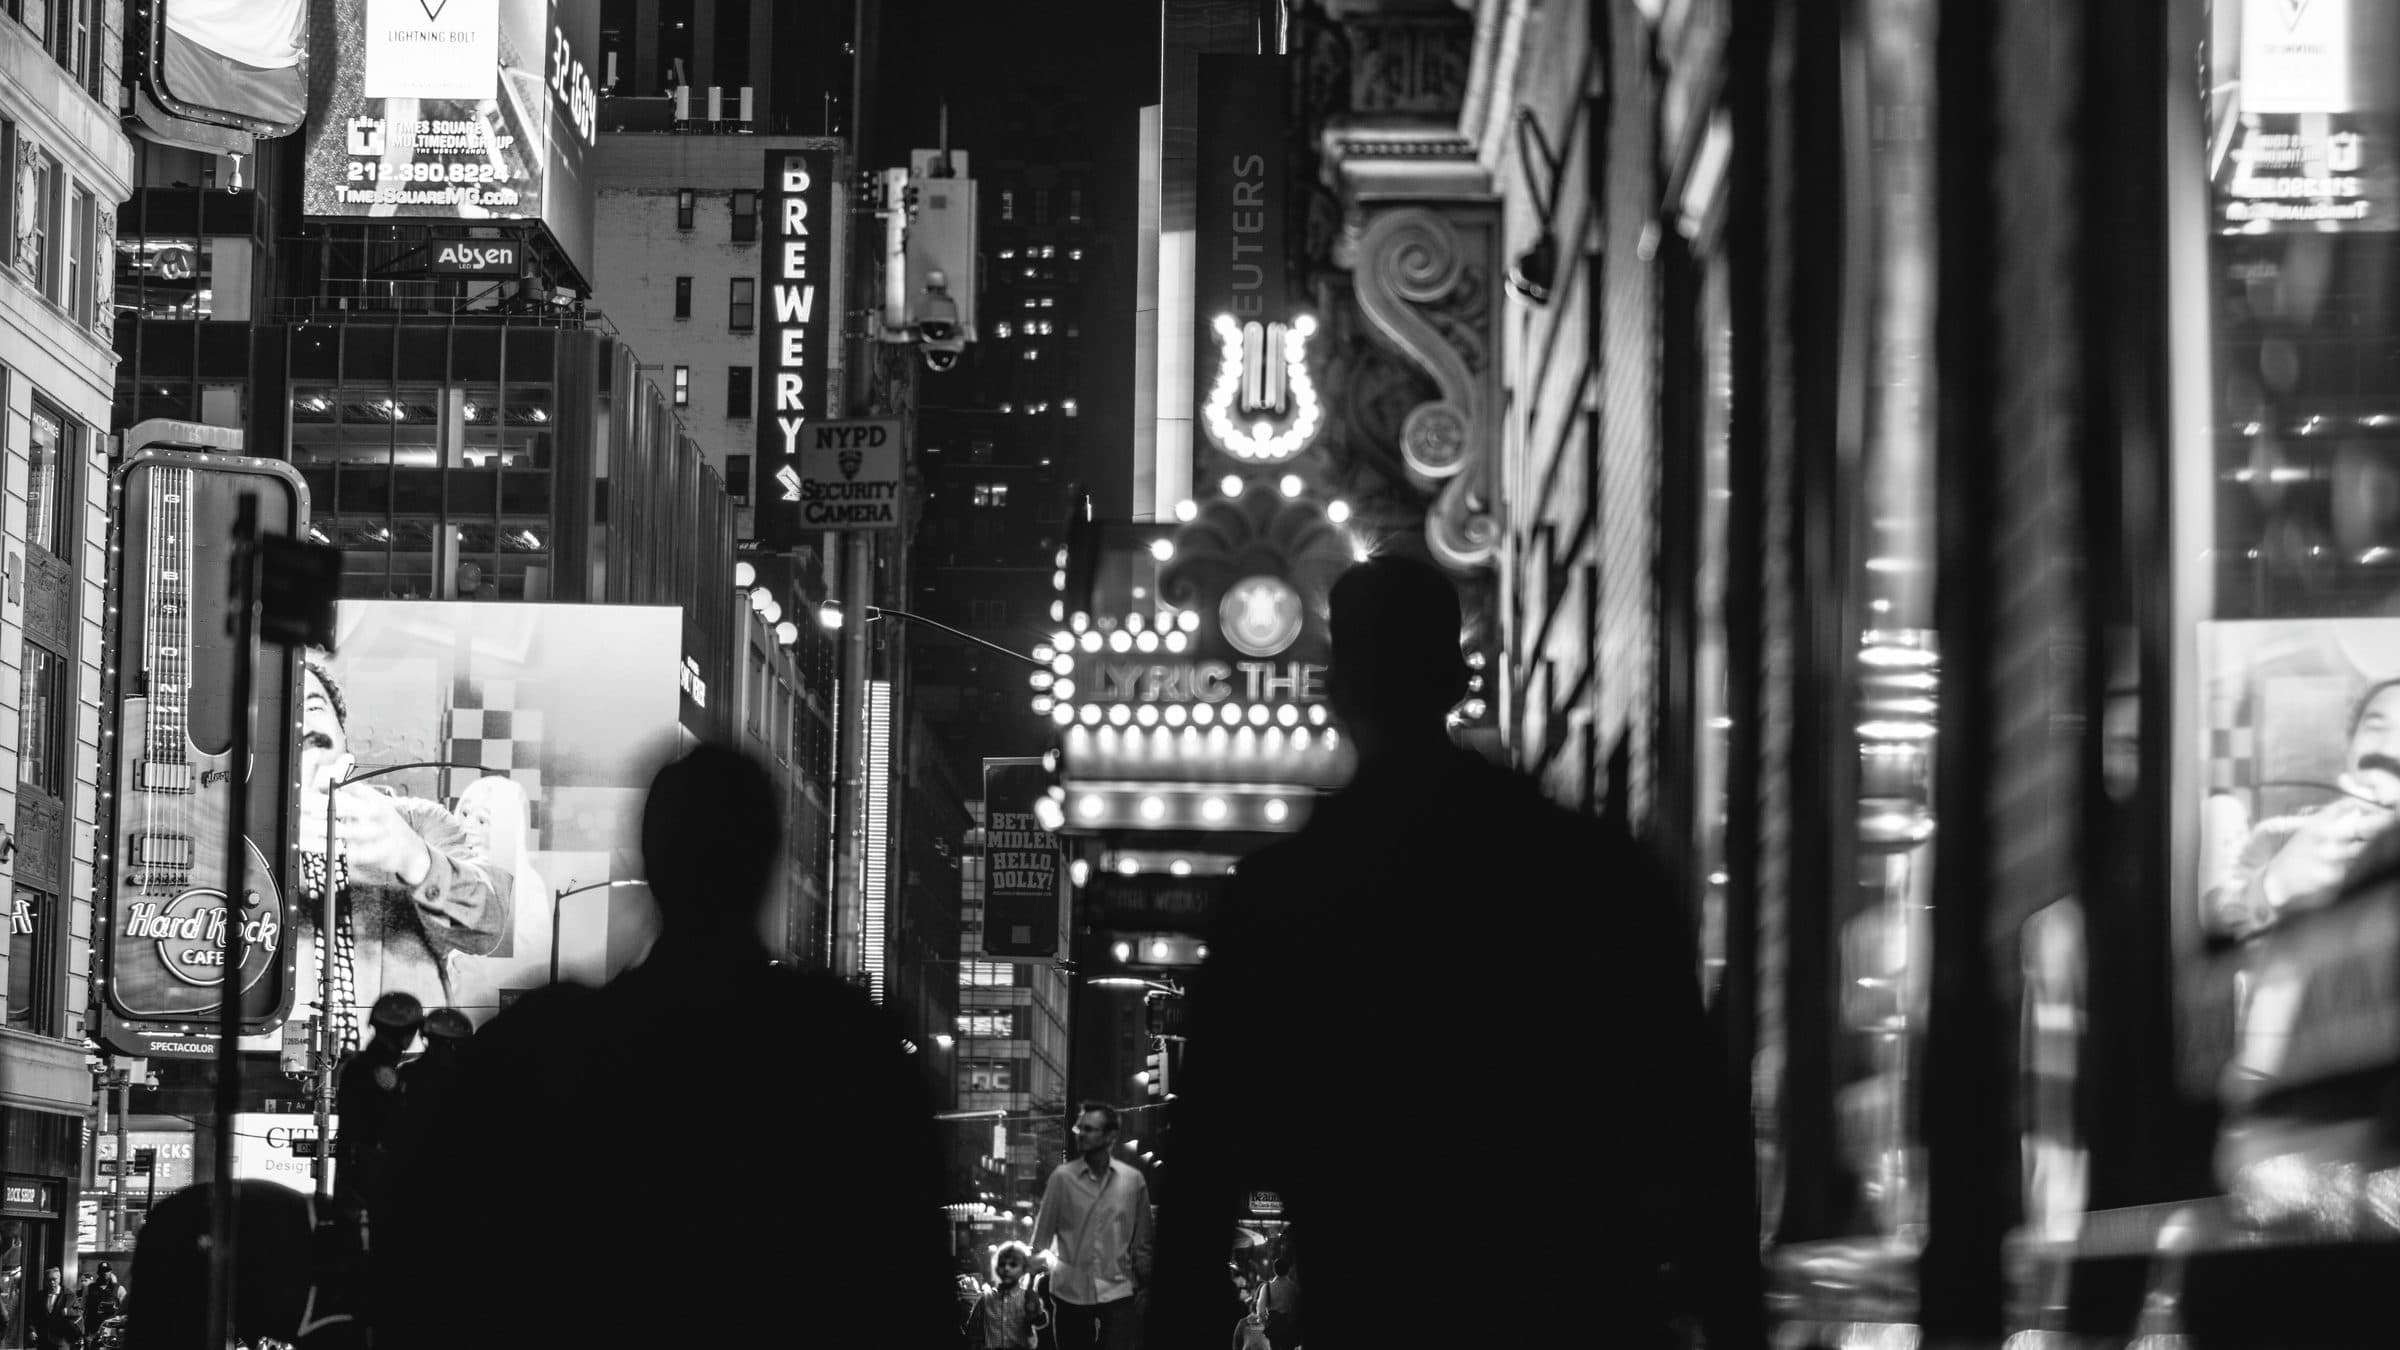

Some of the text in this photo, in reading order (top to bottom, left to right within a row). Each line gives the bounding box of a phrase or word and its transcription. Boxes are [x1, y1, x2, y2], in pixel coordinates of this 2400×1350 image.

[388, 30, 476, 43] LIGHTNING BOLT
[393, 120, 482, 134] TIMES SQUARE
[392, 135, 468, 148] MULTIMEDIA
[347, 162, 509, 183] 212.390.8224
[1231, 154, 1264, 318] EUTERS
[438, 243, 513, 269] Absen
[774, 156, 815, 453] BREWERY
[816, 425, 887, 448] NYPD
[1088, 661, 1329, 703] LYRIC THE
[987, 831, 1059, 849] MIDLER
[992, 871, 1054, 891] DOLLY!
[127, 902, 277, 952] Hard Rck
[150, 1041, 214, 1053] SPECTACOLOR
[286, 1101, 293, 1112] 7
